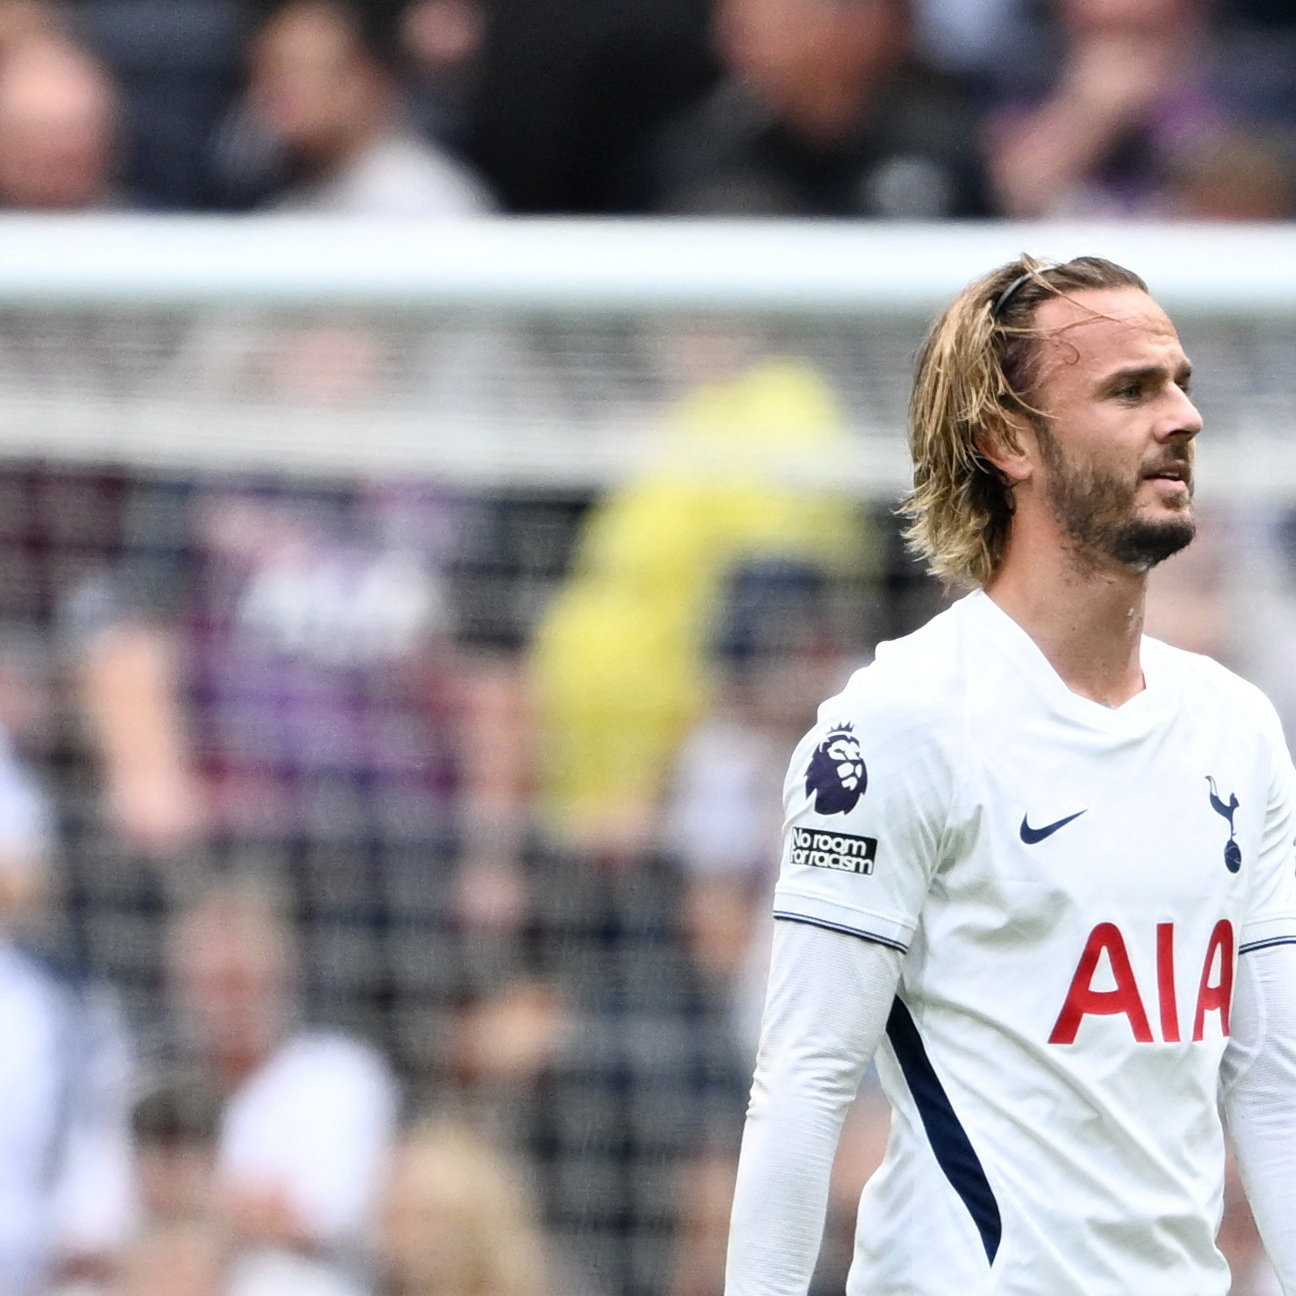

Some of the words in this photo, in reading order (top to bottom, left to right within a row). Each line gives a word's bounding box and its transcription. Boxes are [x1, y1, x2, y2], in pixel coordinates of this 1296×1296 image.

[792, 828, 811, 849] No
[812, 833, 867, 857] room
[807, 850, 873, 875] racism
[1047, 918, 1235, 1045] AIA
